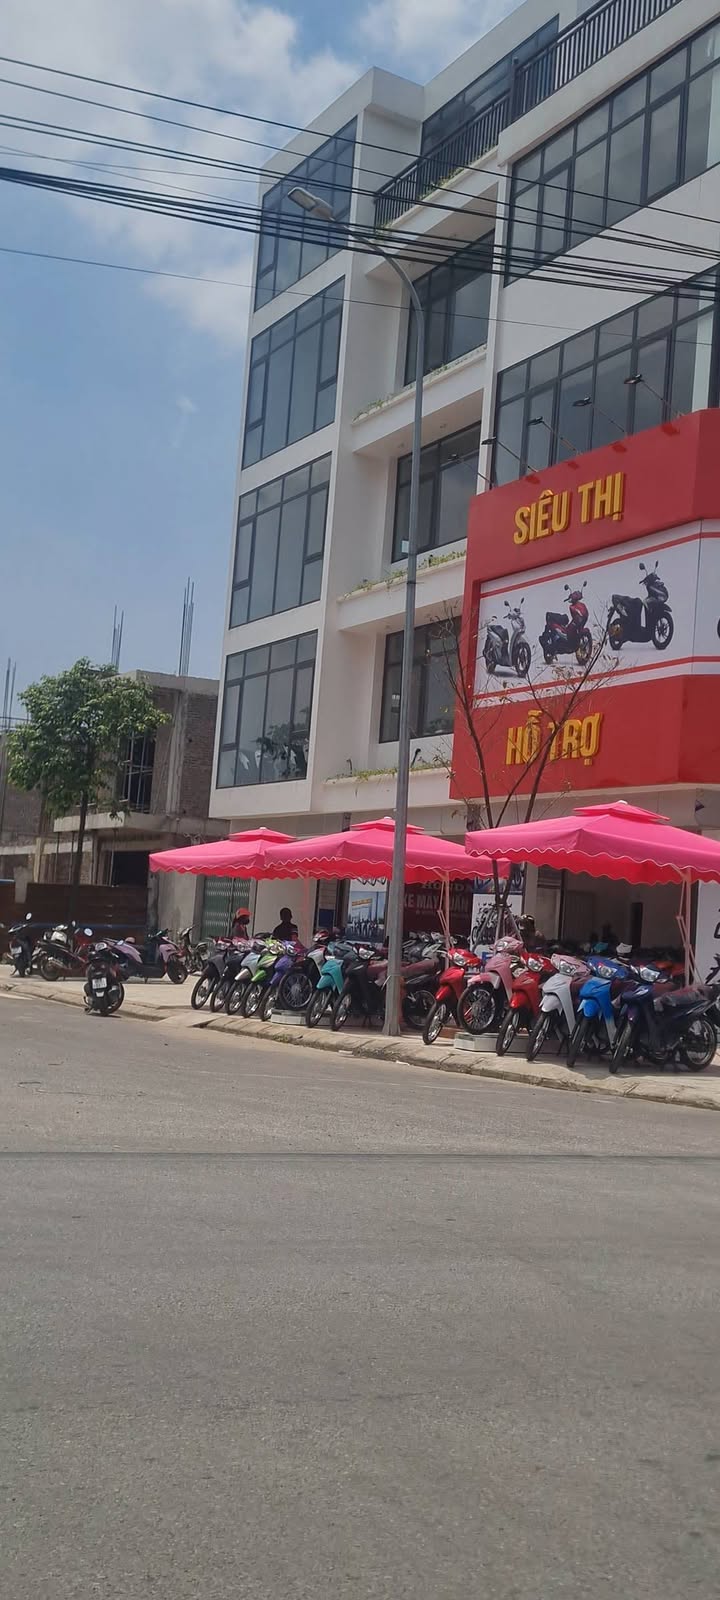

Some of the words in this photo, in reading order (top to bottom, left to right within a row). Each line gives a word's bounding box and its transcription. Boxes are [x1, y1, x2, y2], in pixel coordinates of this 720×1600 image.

[513, 489, 572, 545] SIÊU
[578, 472, 626, 522] THỊ
[505, 709, 543, 765] HỖ
[547, 712, 603, 766] TRỢ
